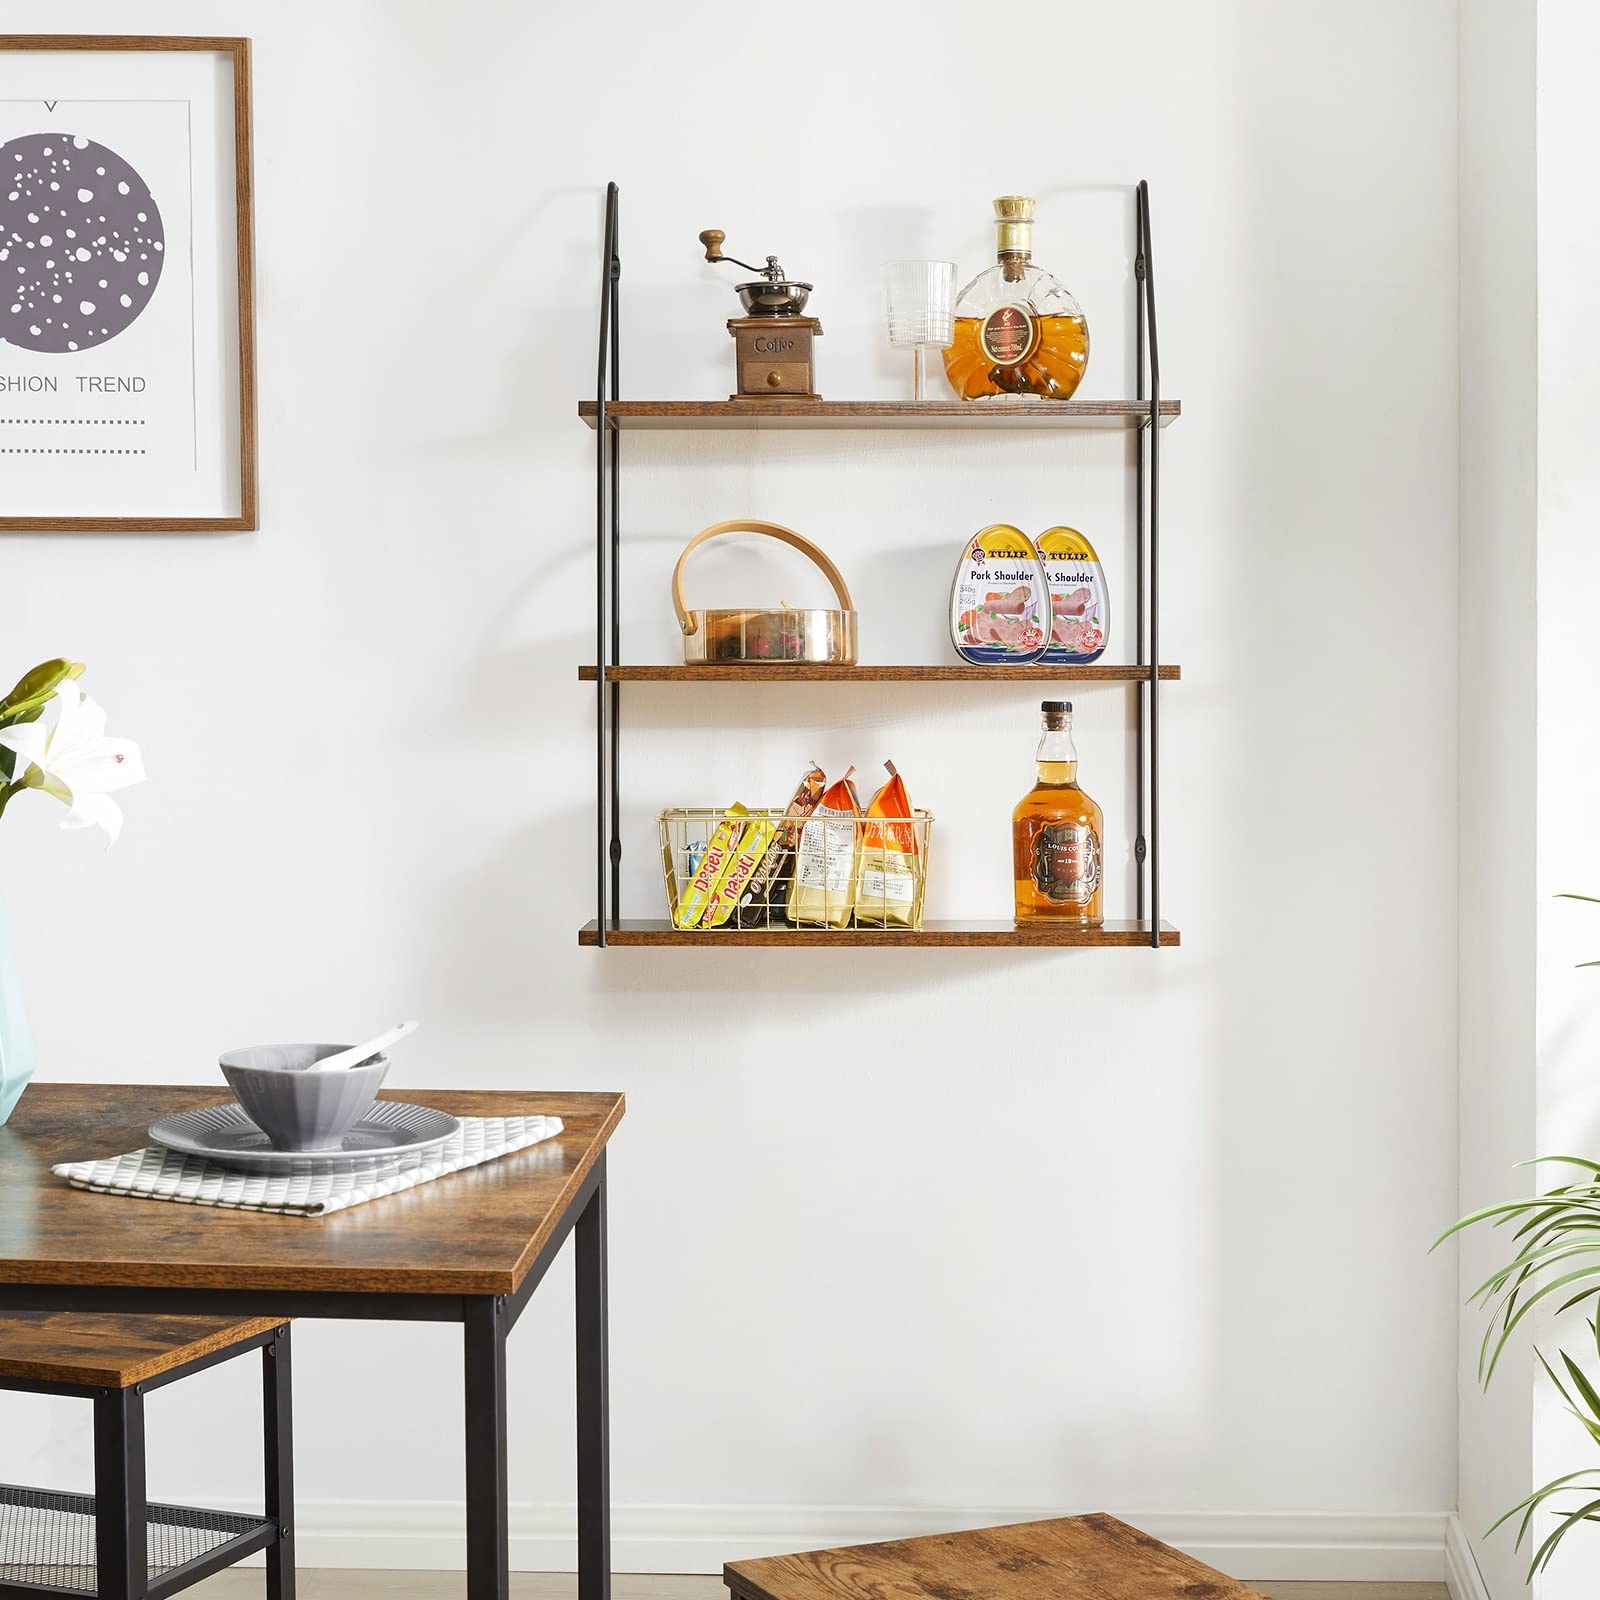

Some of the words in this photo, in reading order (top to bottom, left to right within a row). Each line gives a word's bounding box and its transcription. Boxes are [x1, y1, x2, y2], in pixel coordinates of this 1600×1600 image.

[754, 336, 794, 353] Coffee
[76, 376, 147, 393] TREND
[988, 549, 1028, 559] TULIP
[1049, 551, 1089, 561] TULIP
[970, 570, 991, 581] Pork
[994, 570, 1034, 581] Shoulder
[1055, 572, 1094, 583] Shoulder
[722, 853, 756, 900] nabati
